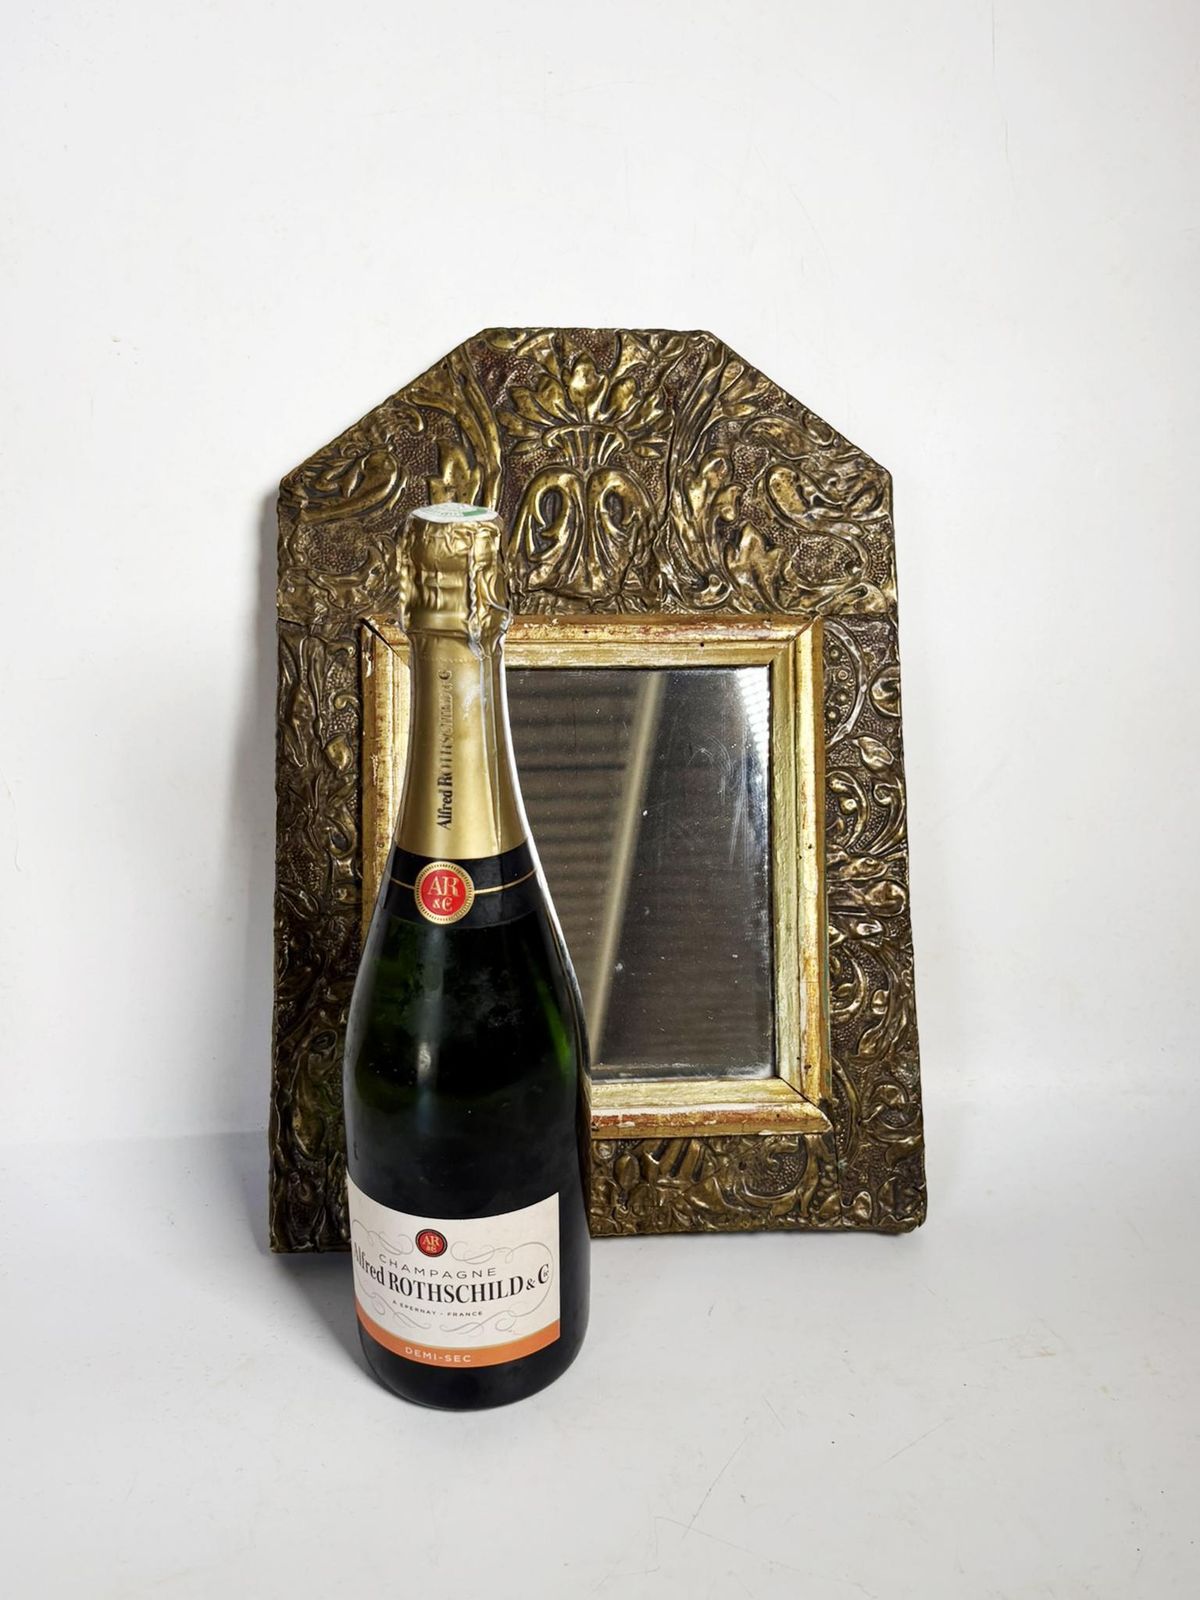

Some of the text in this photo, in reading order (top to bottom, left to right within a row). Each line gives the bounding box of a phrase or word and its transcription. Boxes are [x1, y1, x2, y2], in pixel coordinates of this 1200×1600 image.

[436, 789, 453, 831] Alfred
[427, 876, 460, 897] AR
[353, 1241, 385, 1286] Alfred
[388, 1271, 524, 1304] ROTHSCHILD
[526, 1278, 536, 1290] &
[378, 1253, 497, 1280] CHAMPAGNE
[405, 1346, 472, 1363] DEMI-SEC
